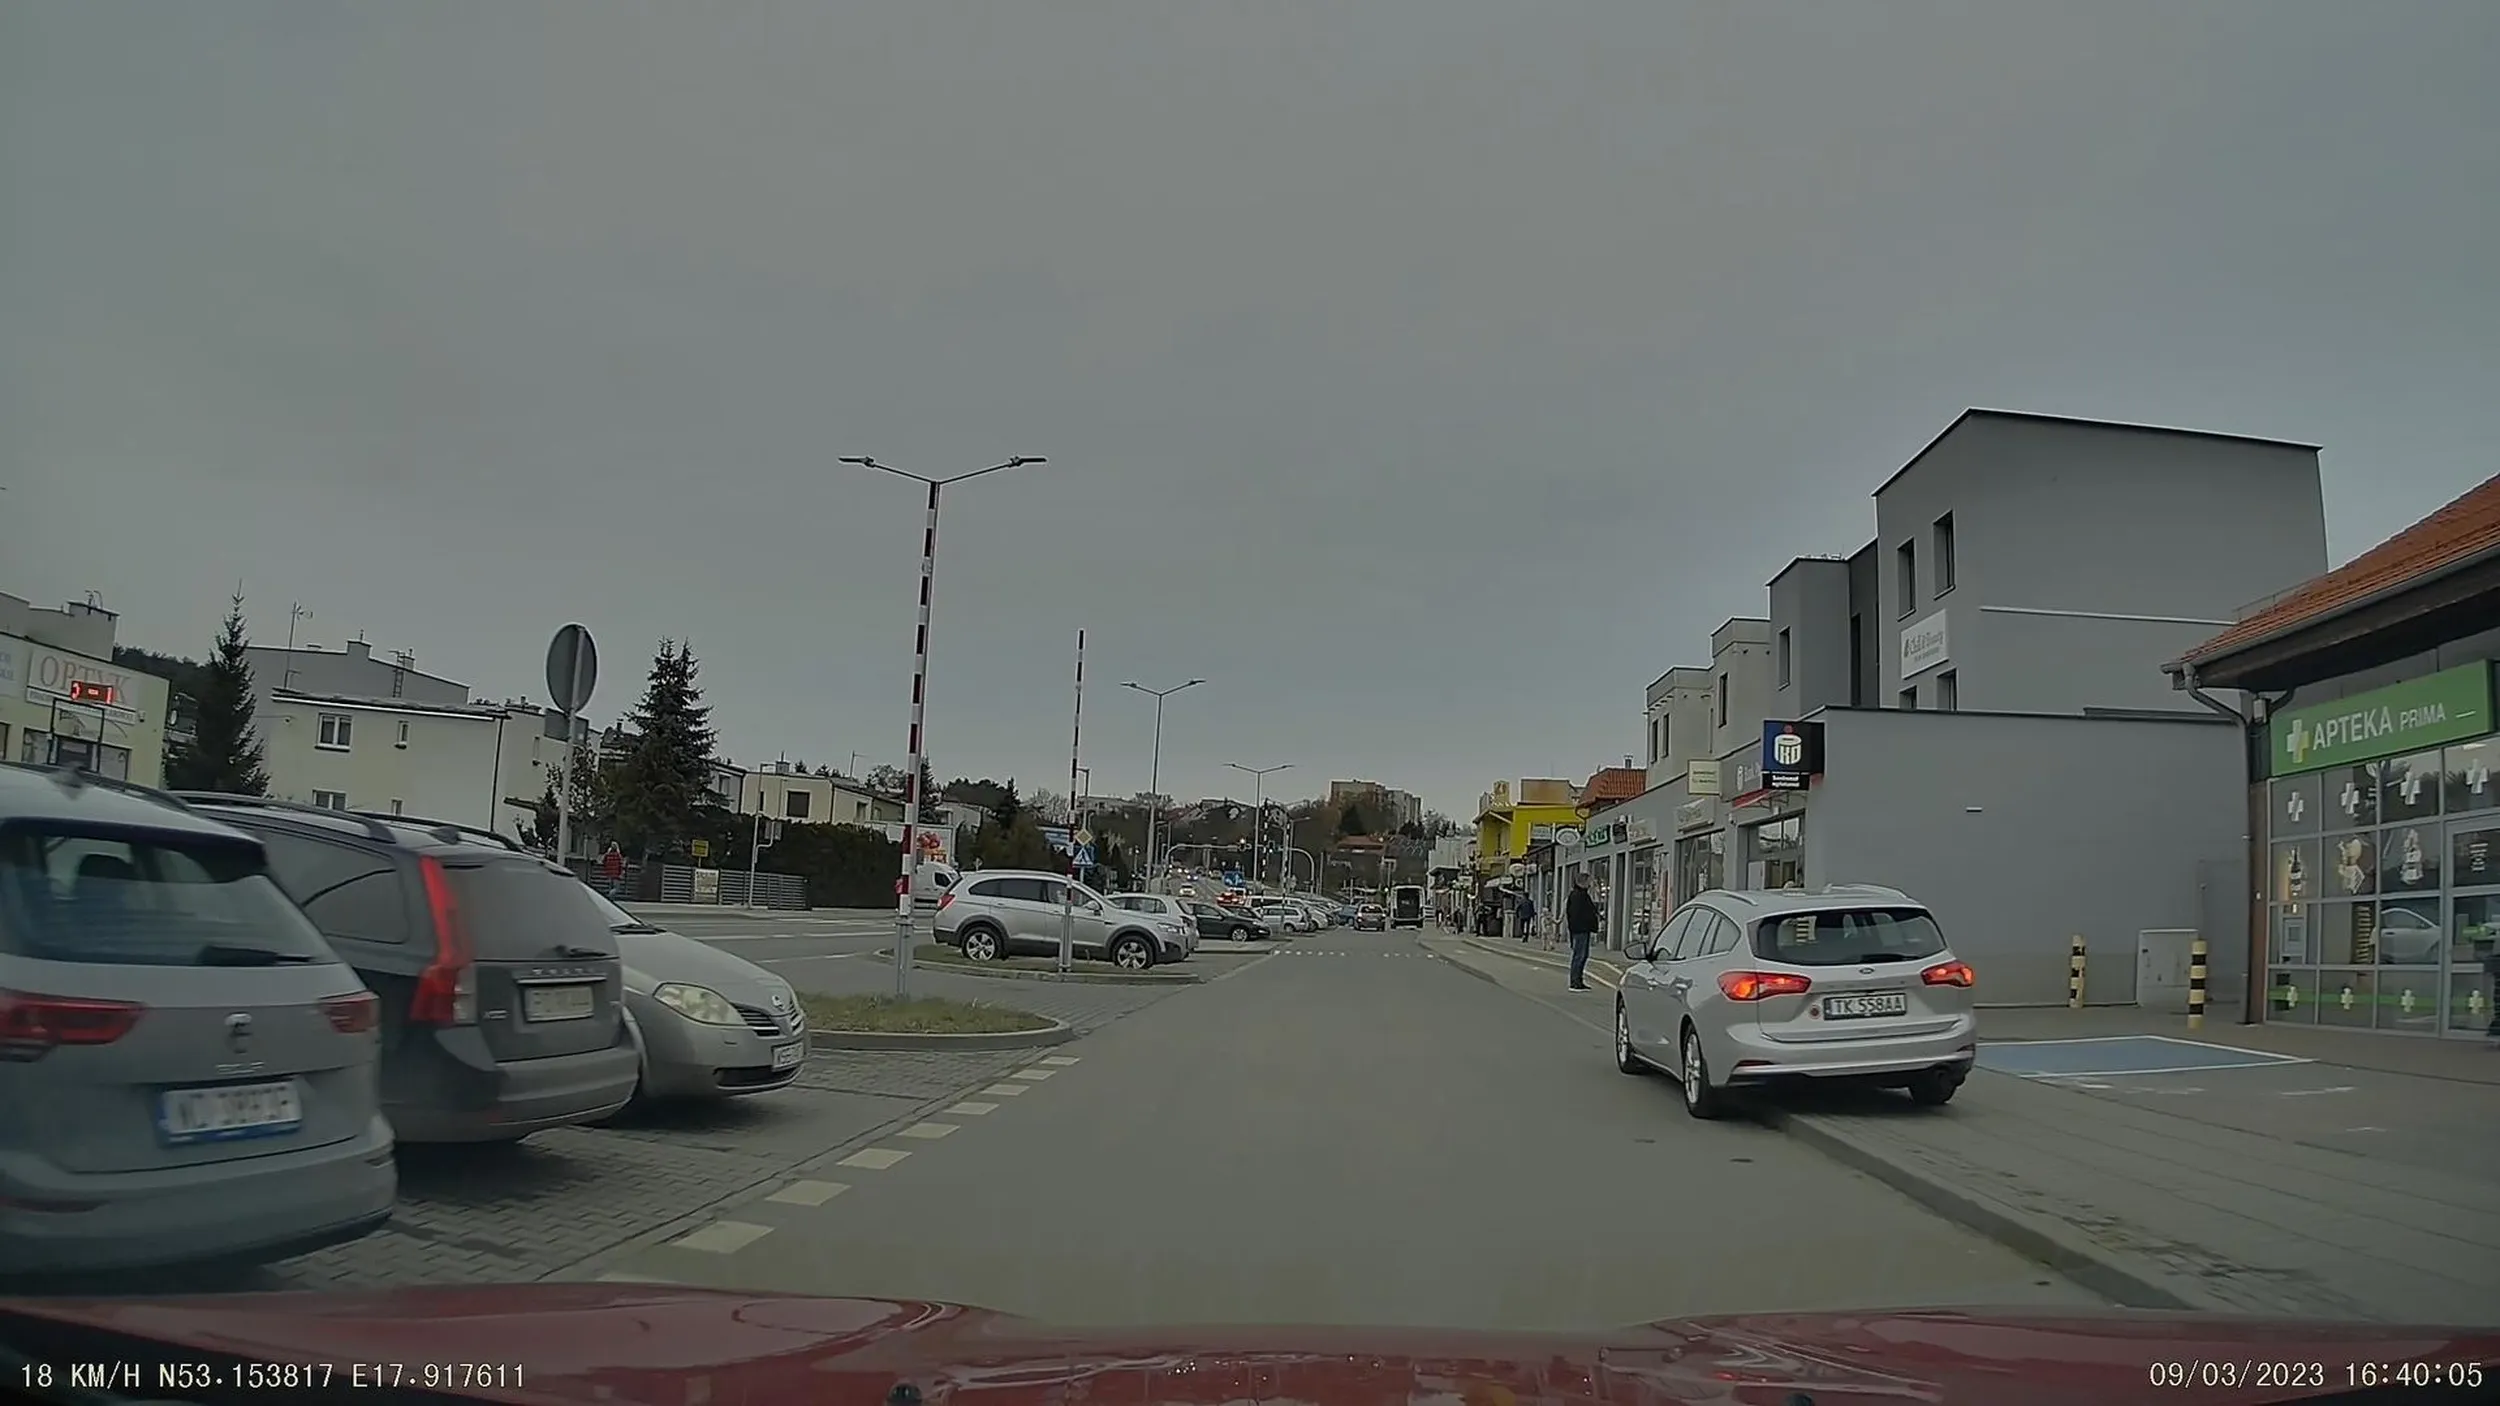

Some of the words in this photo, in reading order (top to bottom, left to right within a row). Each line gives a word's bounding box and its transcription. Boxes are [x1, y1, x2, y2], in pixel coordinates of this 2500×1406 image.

[2313, 706, 2393, 751] APTEKA
[2400, 703, 2446, 731] PRIMA
[1834, 999, 1853, 1013] TK
